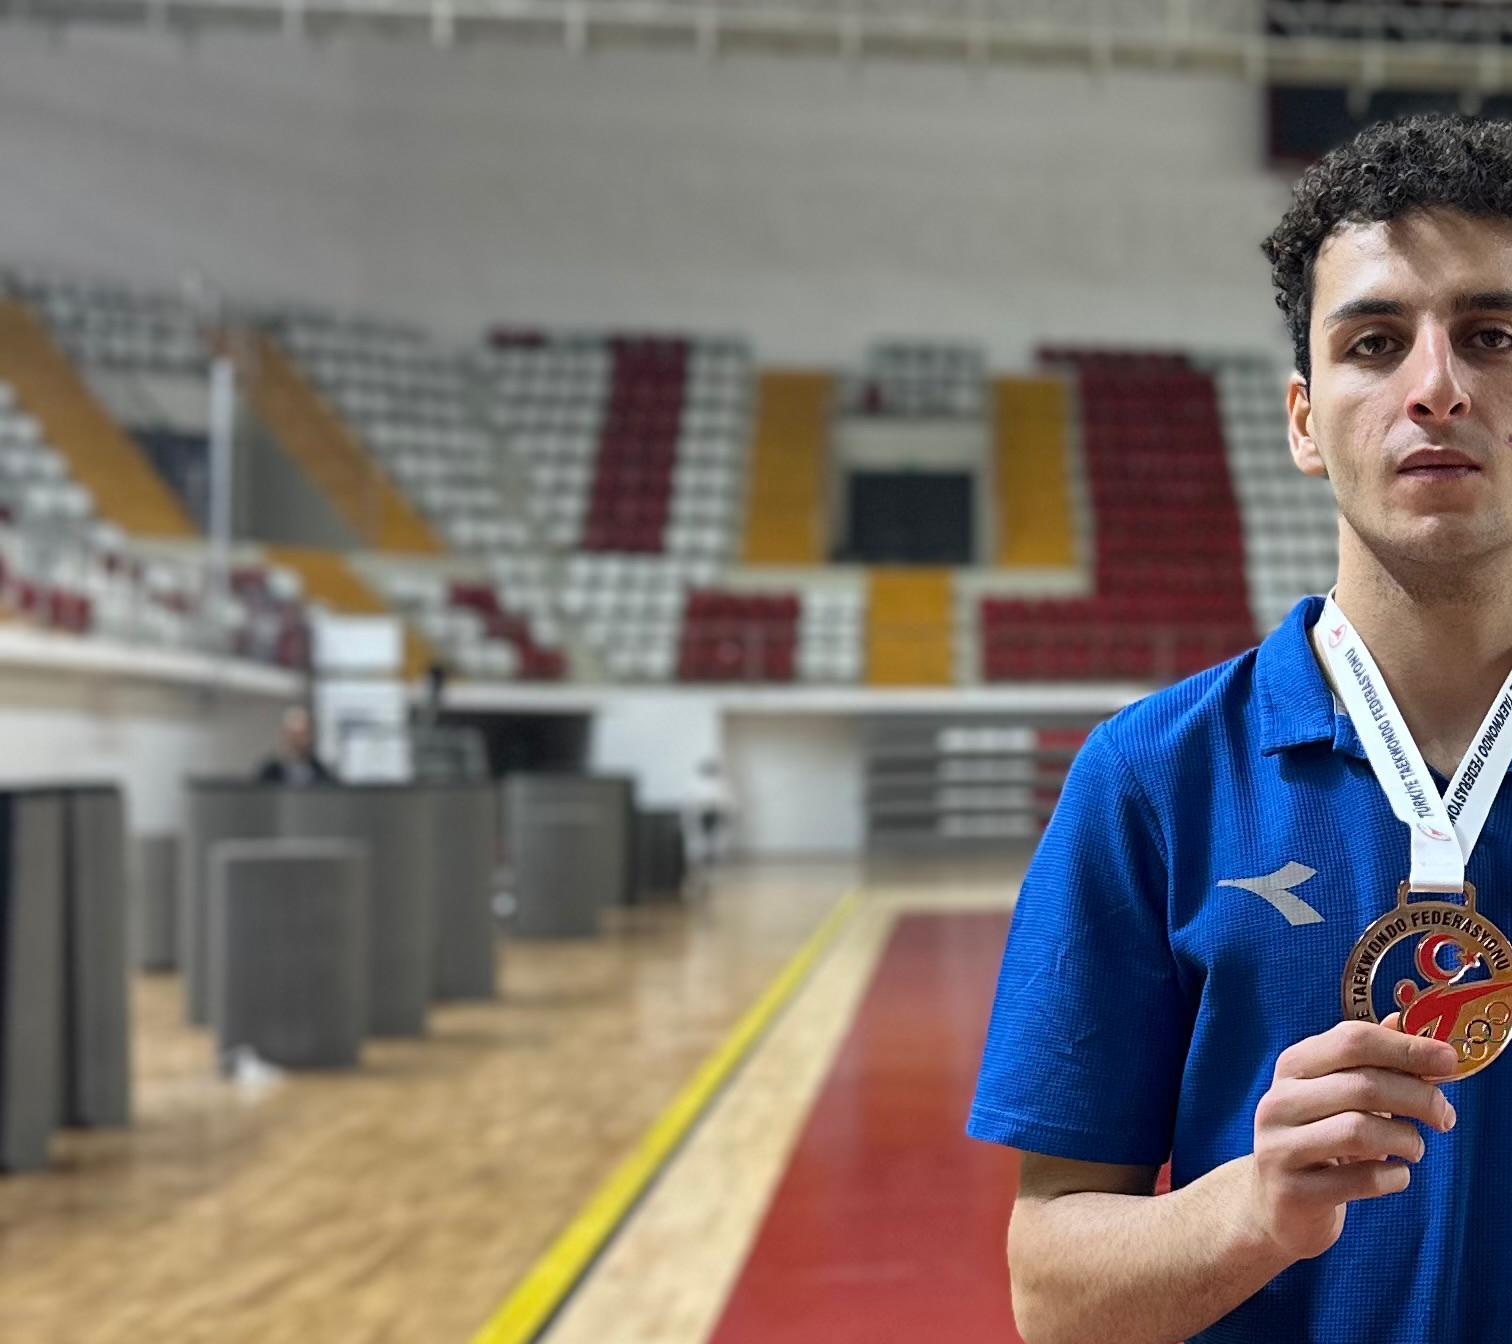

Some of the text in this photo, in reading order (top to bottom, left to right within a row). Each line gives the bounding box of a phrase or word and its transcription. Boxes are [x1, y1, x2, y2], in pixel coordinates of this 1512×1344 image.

[1345, 646, 1435, 818] TÜRKİYE TAEKWONDO FEDERASYONU
[1446, 752, 1485, 826] FEDERASYON
[1352, 910, 1511, 1006] TAEKWONDO FEDERASYONU
